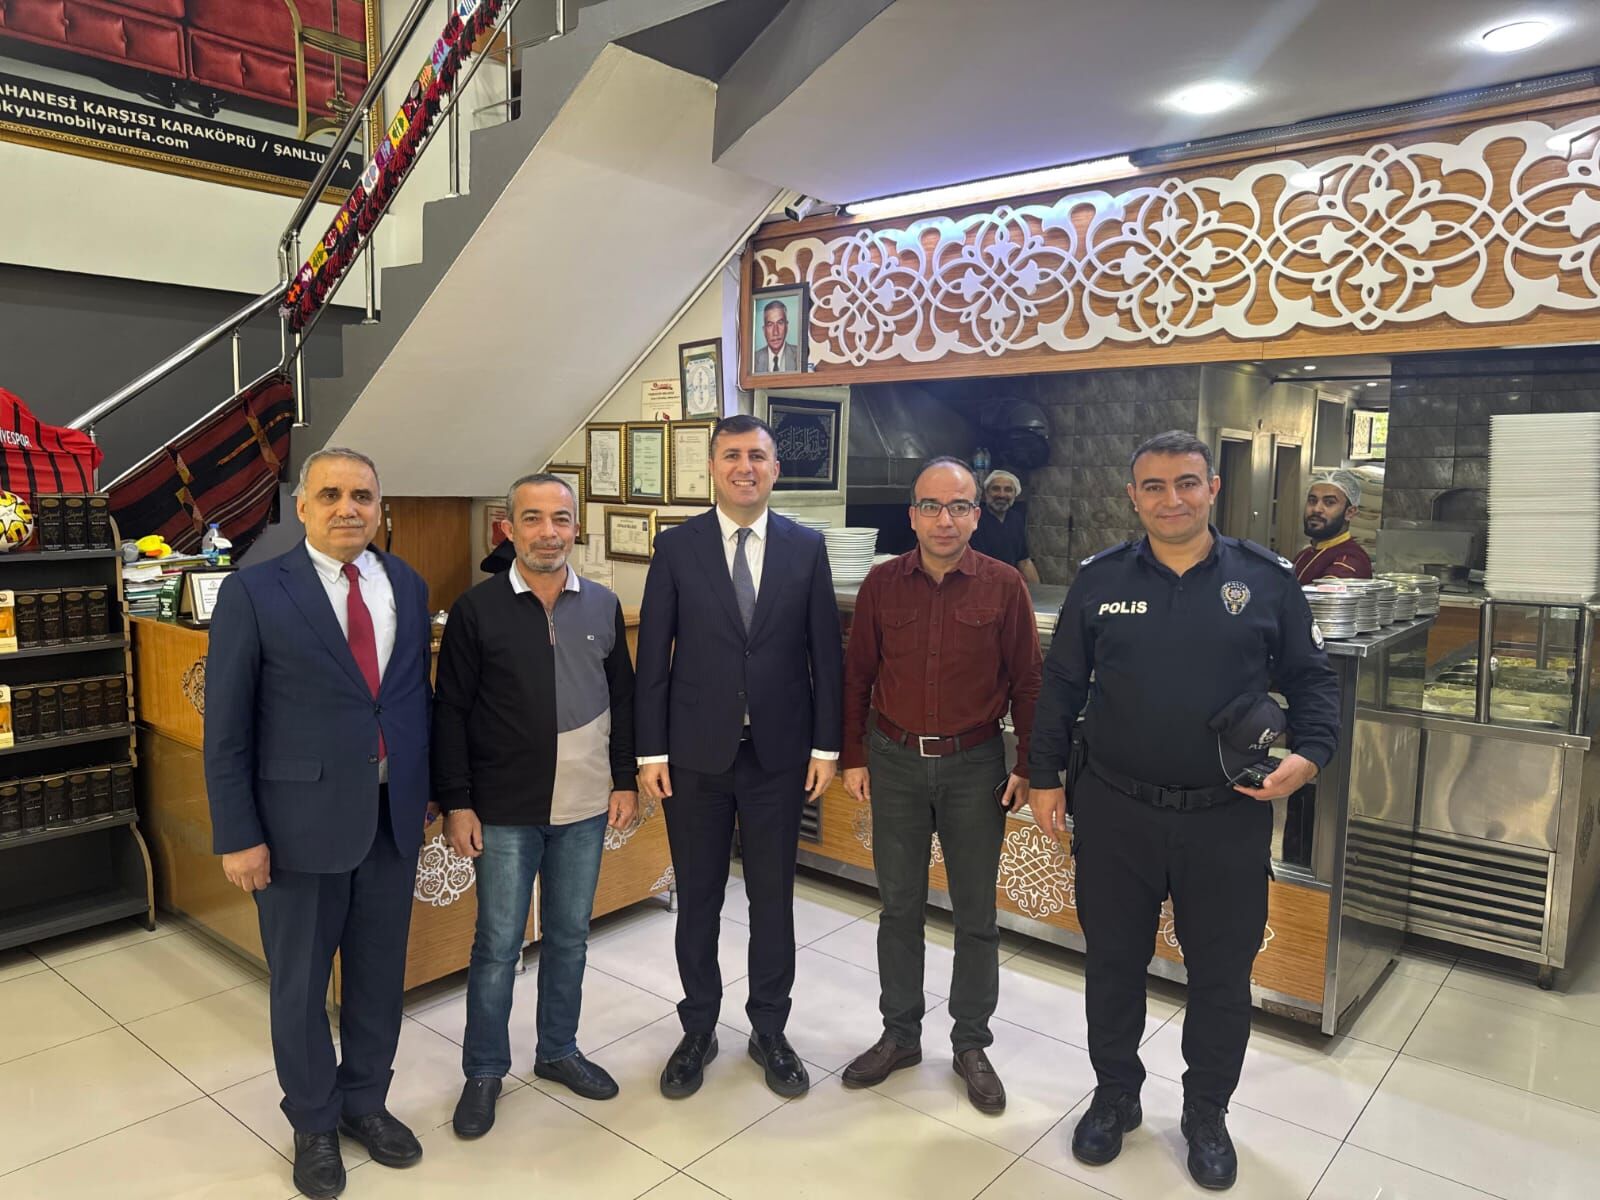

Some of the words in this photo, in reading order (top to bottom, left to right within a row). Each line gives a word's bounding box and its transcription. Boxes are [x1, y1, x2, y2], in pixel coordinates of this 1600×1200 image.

[0, 99, 190, 149] kyuzmobilyaurfa.com
[83, 101, 156, 127] KARŞISI
[161, 118, 256, 149] KARAKÖPRÜ
[261, 140, 269, 152] /
[273, 143, 352, 170] ŞANLIUA
